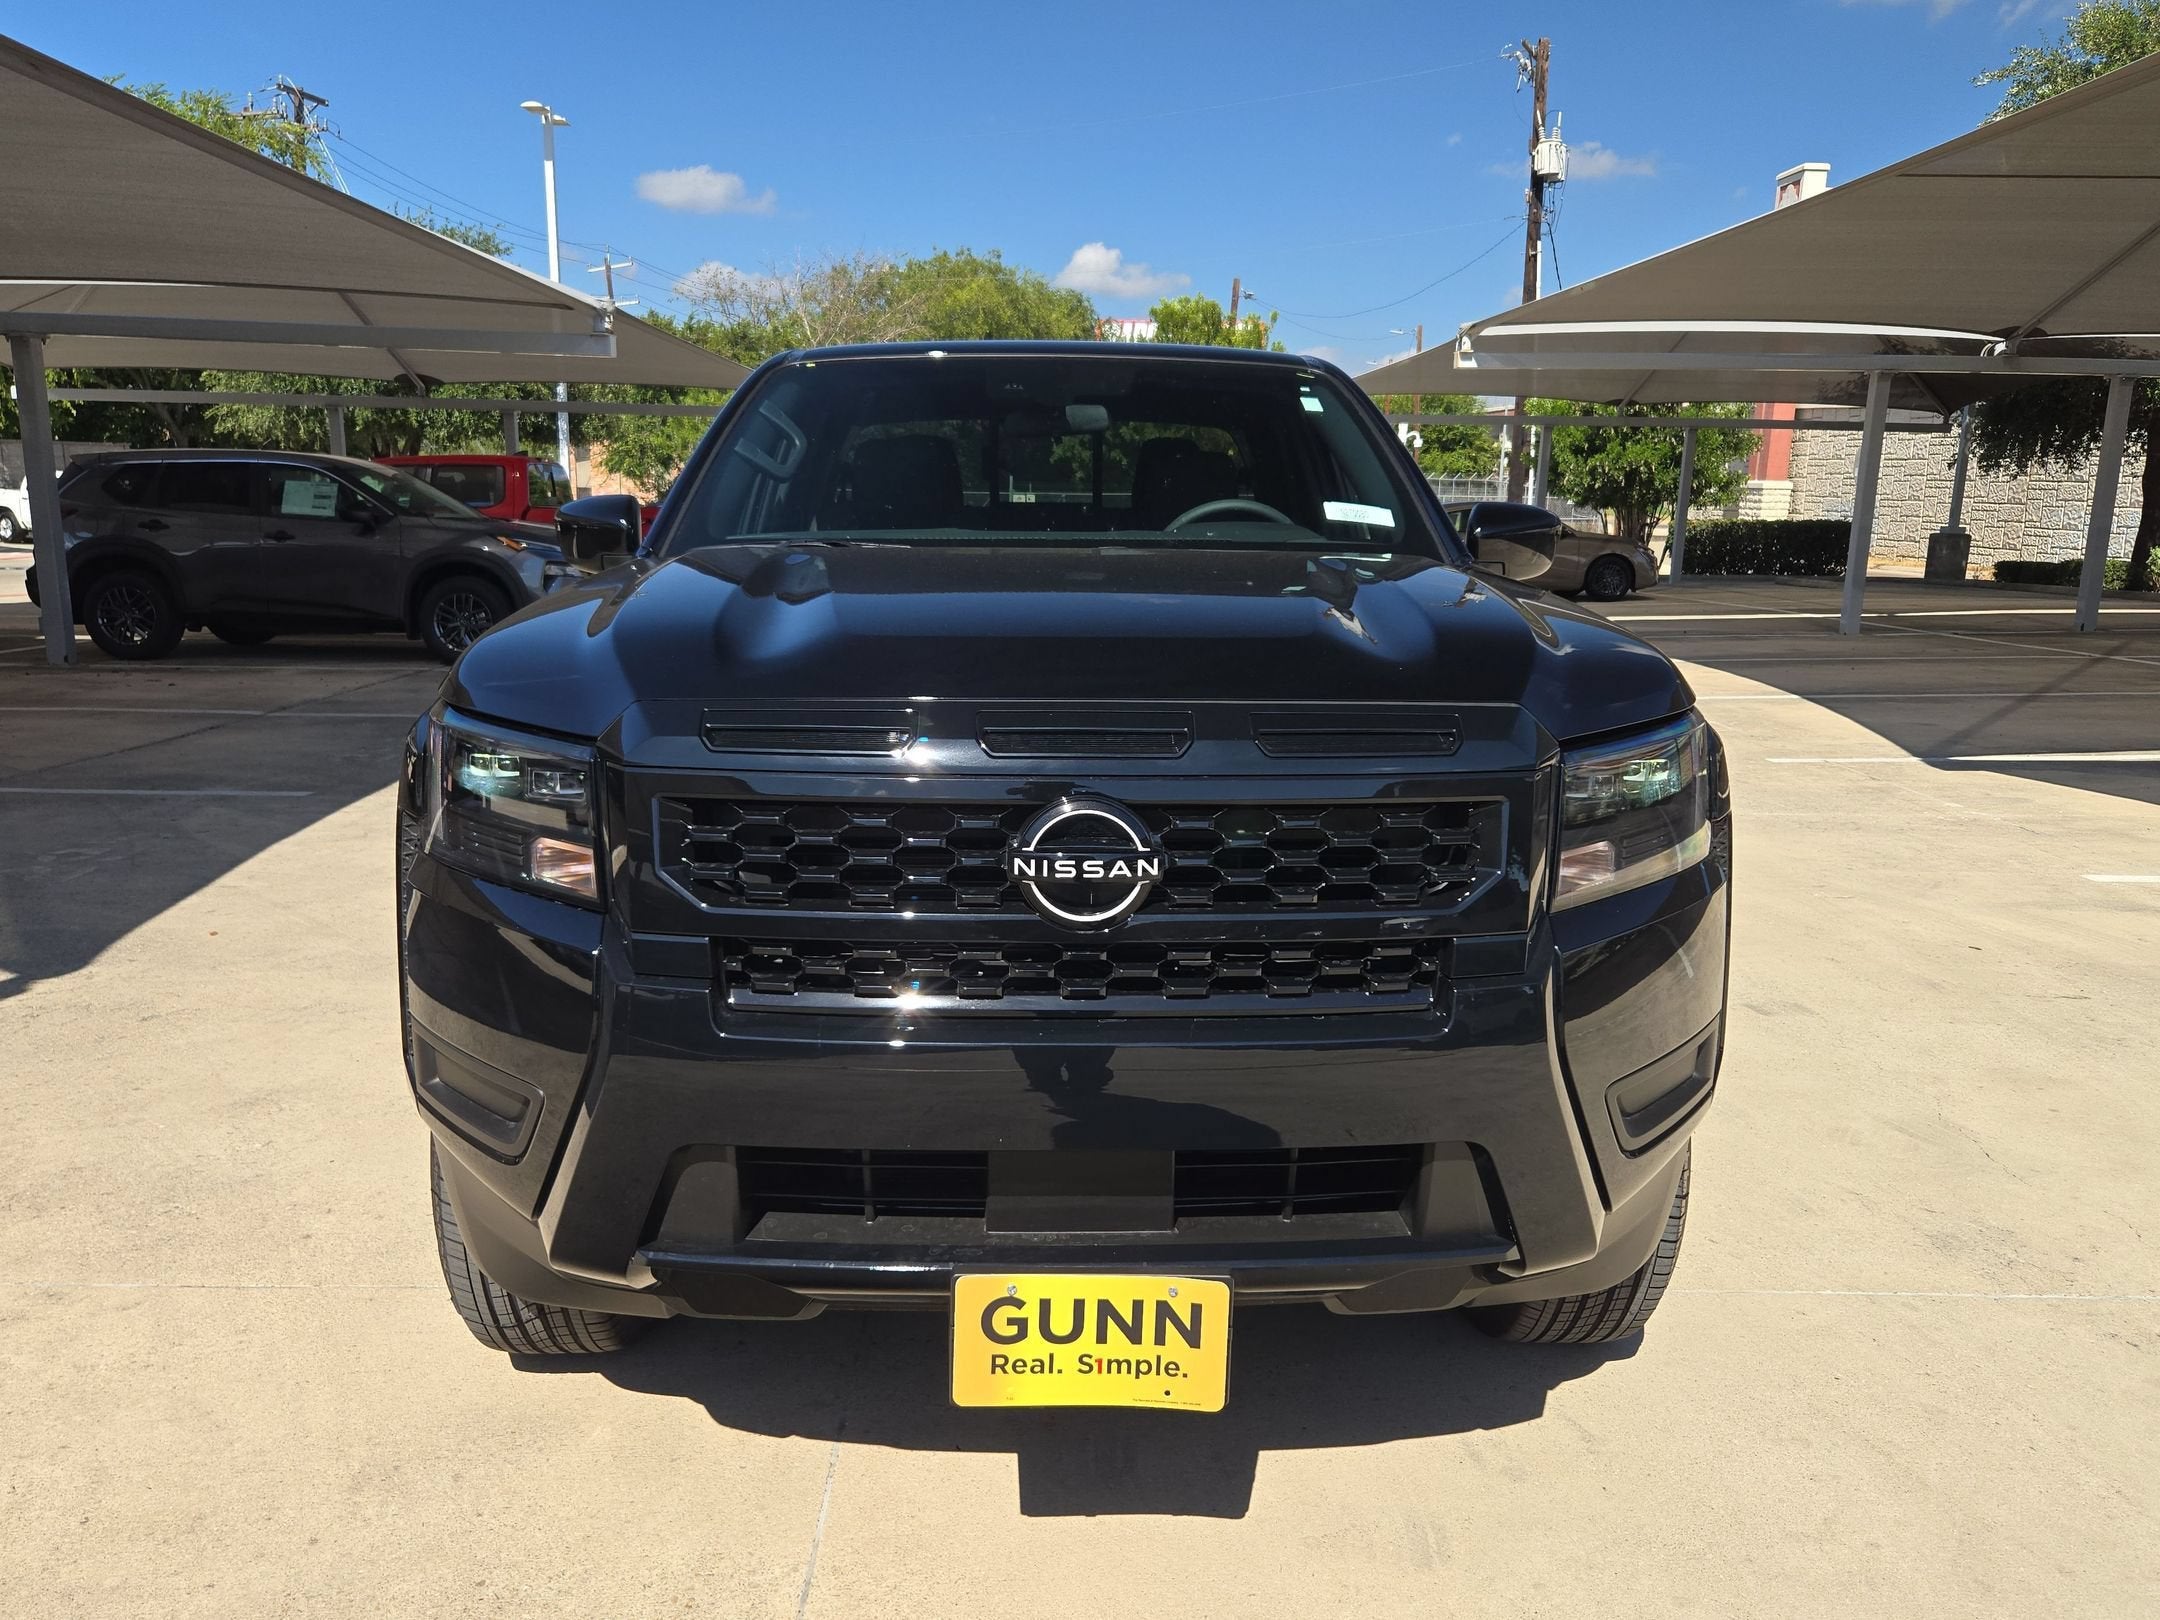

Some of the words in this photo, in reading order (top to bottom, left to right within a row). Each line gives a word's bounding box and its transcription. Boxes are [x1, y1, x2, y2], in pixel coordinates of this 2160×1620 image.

[1013, 857, 1159, 878] NISSAN
[980, 1296, 1203, 1349] GUNN
[990, 1353, 1063, 1375] Real.
